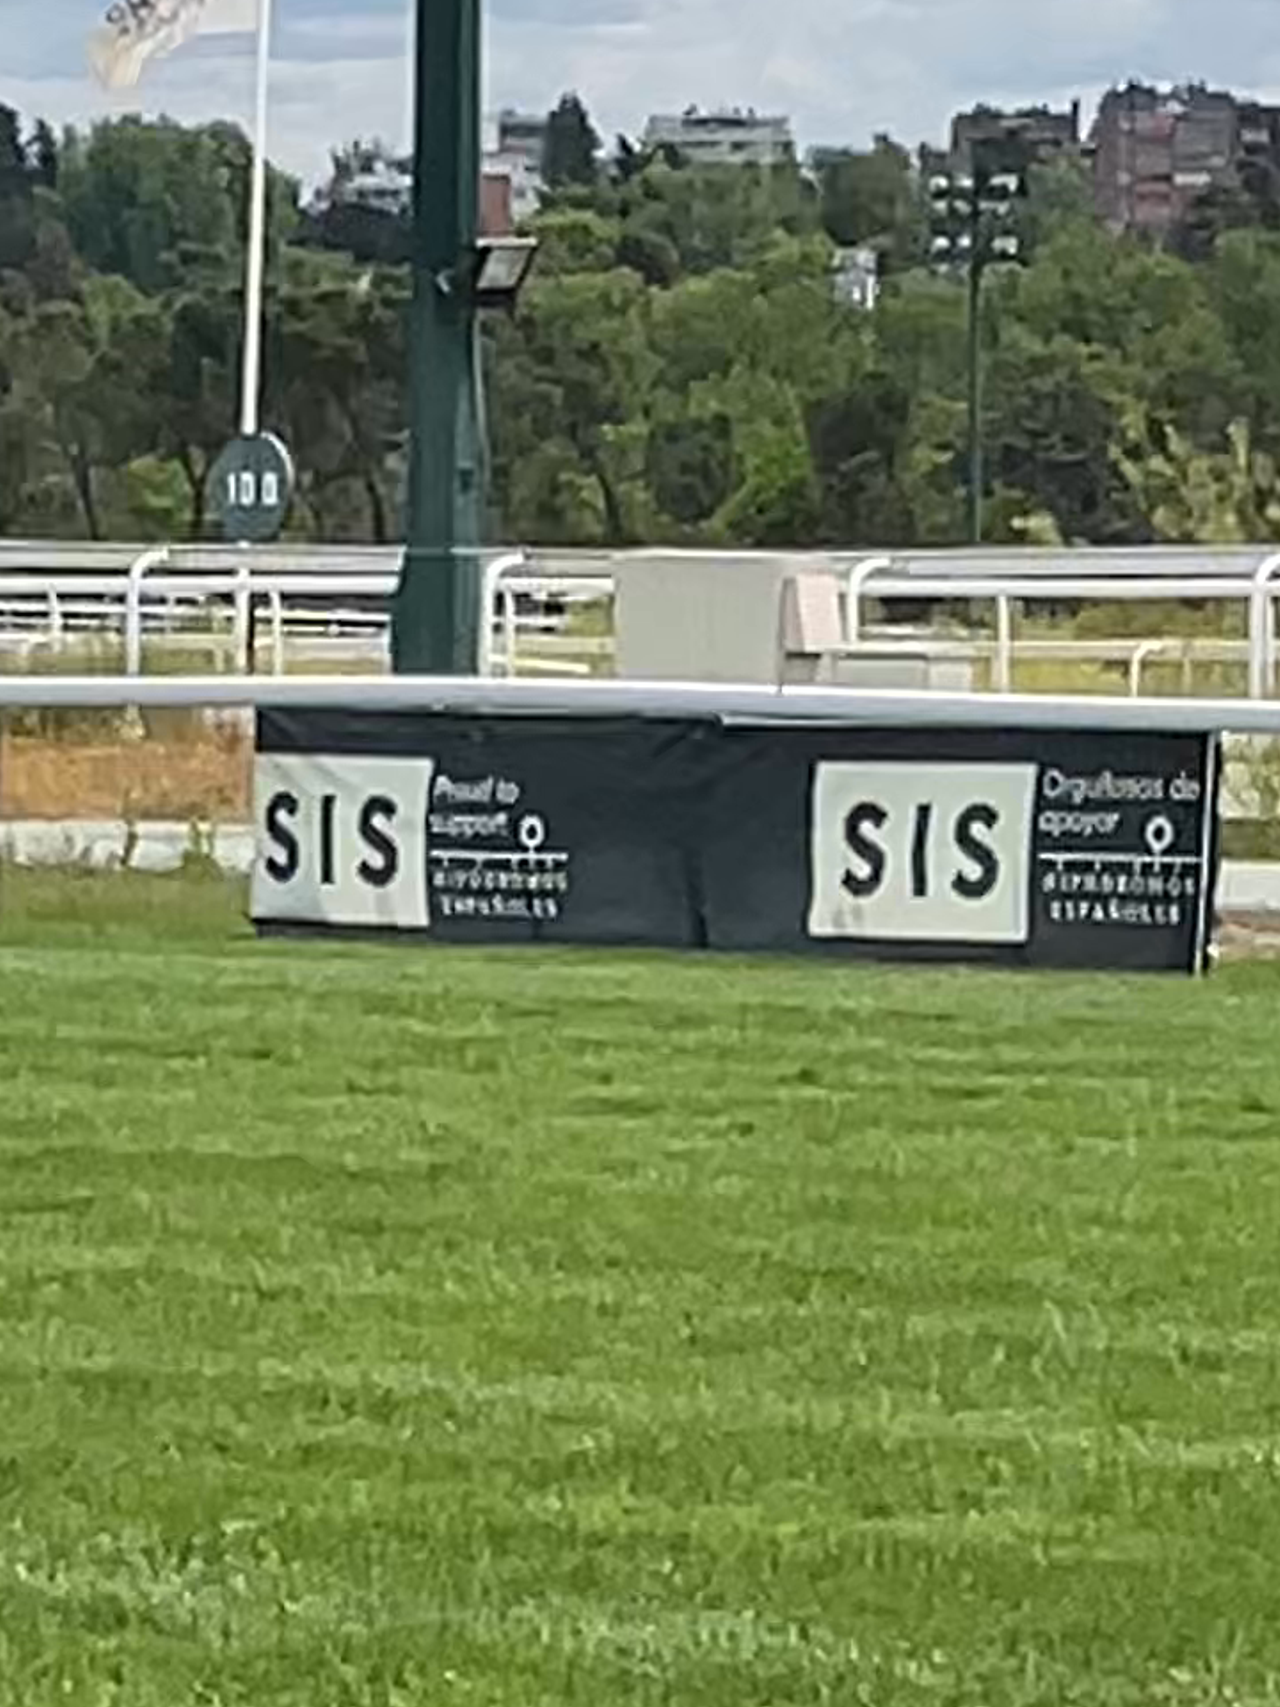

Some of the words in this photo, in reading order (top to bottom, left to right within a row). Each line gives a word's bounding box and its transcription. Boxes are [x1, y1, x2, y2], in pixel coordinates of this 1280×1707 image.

[227, 472, 278, 505] 100
[265, 792, 398, 887] SIS
[841, 801, 1000, 899] SIS
